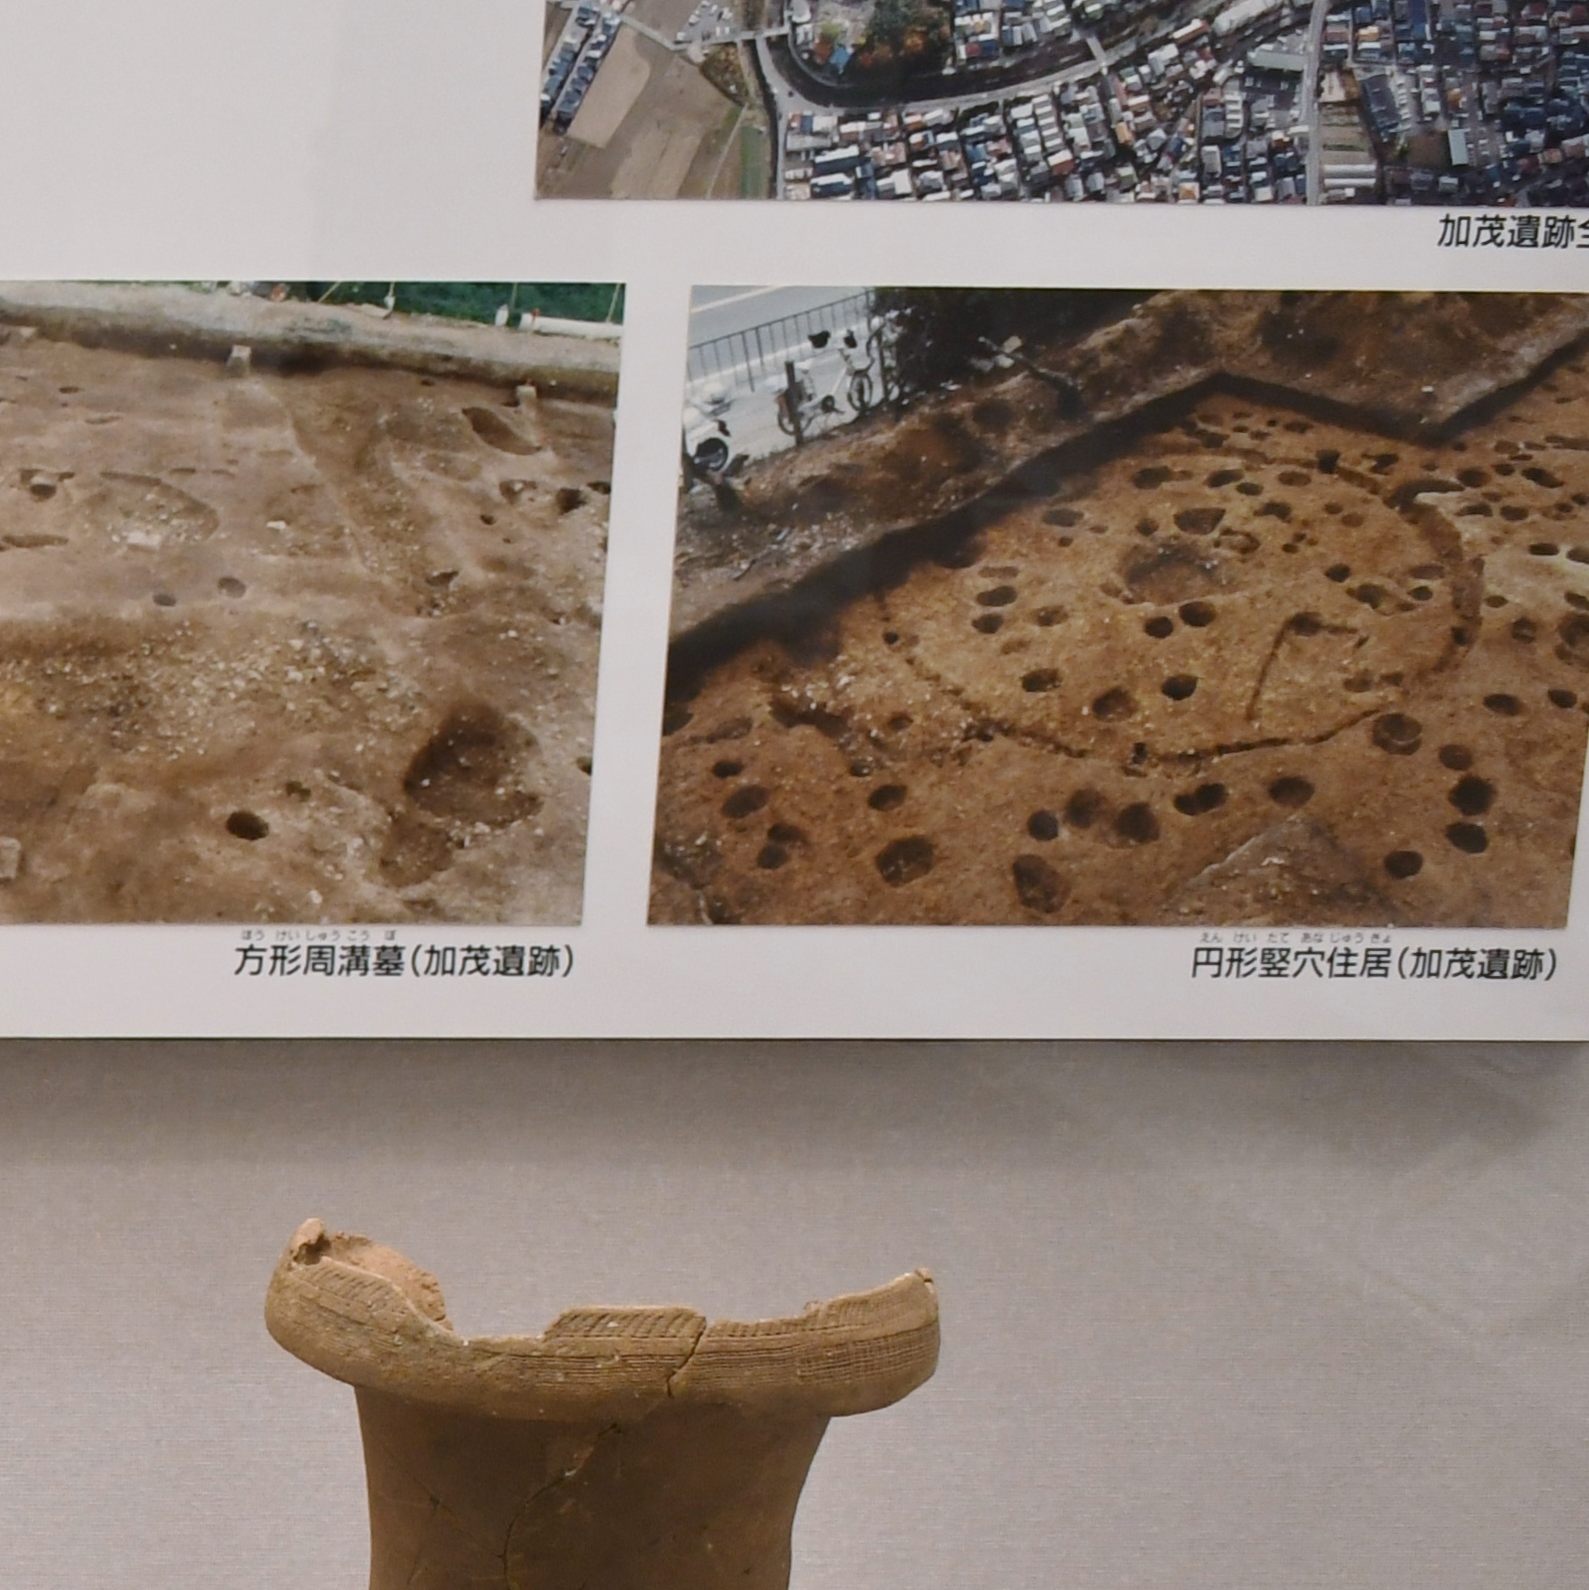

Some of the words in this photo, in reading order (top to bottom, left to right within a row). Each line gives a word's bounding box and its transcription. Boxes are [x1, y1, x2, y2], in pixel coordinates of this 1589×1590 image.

[234, 943, 574, 978] 方形周溝墓（加茂遺跡）
